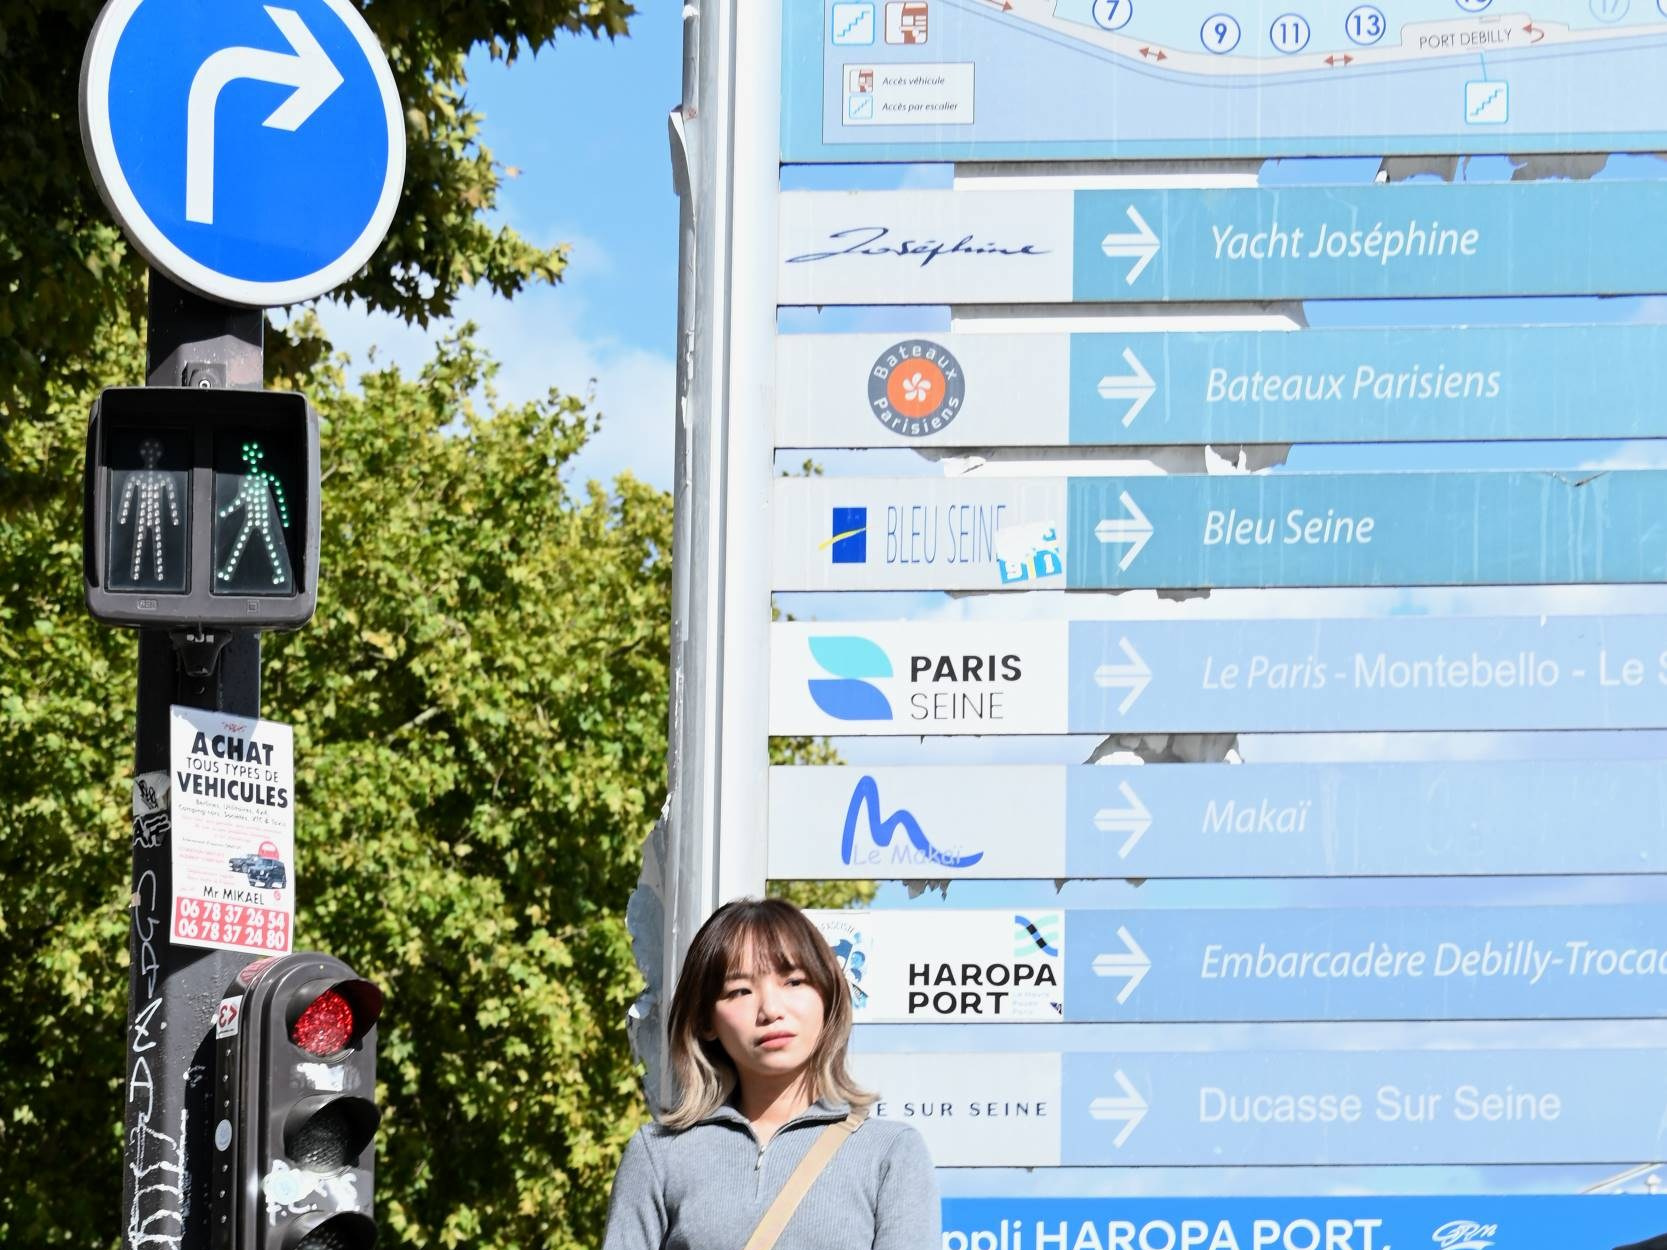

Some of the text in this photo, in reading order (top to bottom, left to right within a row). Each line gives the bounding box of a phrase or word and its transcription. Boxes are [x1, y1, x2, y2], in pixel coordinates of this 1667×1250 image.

[1107, 0, 1119, 21] 7
[1214, 23, 1227, 45] 9
[1279, 23, 1299, 44] 11
[1353, 15, 1380, 37] 13
[1420, 28, 1511, 48] PORT DEBILLY
[882, 75, 945, 85] Accès véhicule
[882, 101, 958, 112] Accès par escalier
[1211, 221, 1479, 265] Yacht Joséphine
[873, 345, 958, 381] Bateaux
[1206, 363, 1501, 402] Bateaux Parisiens
[873, 396, 960, 435] Parisiens
[886, 505, 938, 564] BLEU
[1202, 508, 1375, 546] Bleu Seine
[910, 654, 1022, 683] PARIS
[1202, 656, 1237, 689] Le
[1247, 654, 1326, 689] Paris
[1354, 652, 1559, 688] Montebello
[1600, 650, 1644, 686] Le
[910, 692, 1005, 720] SEINE
[191, 731, 274, 767] ACHAT
[186, 756, 278, 783] TOUS TYPES DE
[177, 771, 288, 809] VEHICULES
[1202, 797, 1312, 833] Makaï
[853, 845, 881, 865] Le
[203, 885, 265, 905] Mr MIKAEL
[180, 898, 285, 929] 06 78 37 26 54
[178, 919, 285, 949] 06 78 37 24 80
[908, 963, 1057, 986] HAROPA
[1201, 942, 1425, 979] Embarcadère
[908, 991, 1009, 1014] PORT
[904, 1102, 953, 1117] SUR
[970, 1102, 1048, 1117] SEINE
[1200, 1085, 1561, 1123] Ducasse Sur Seine
